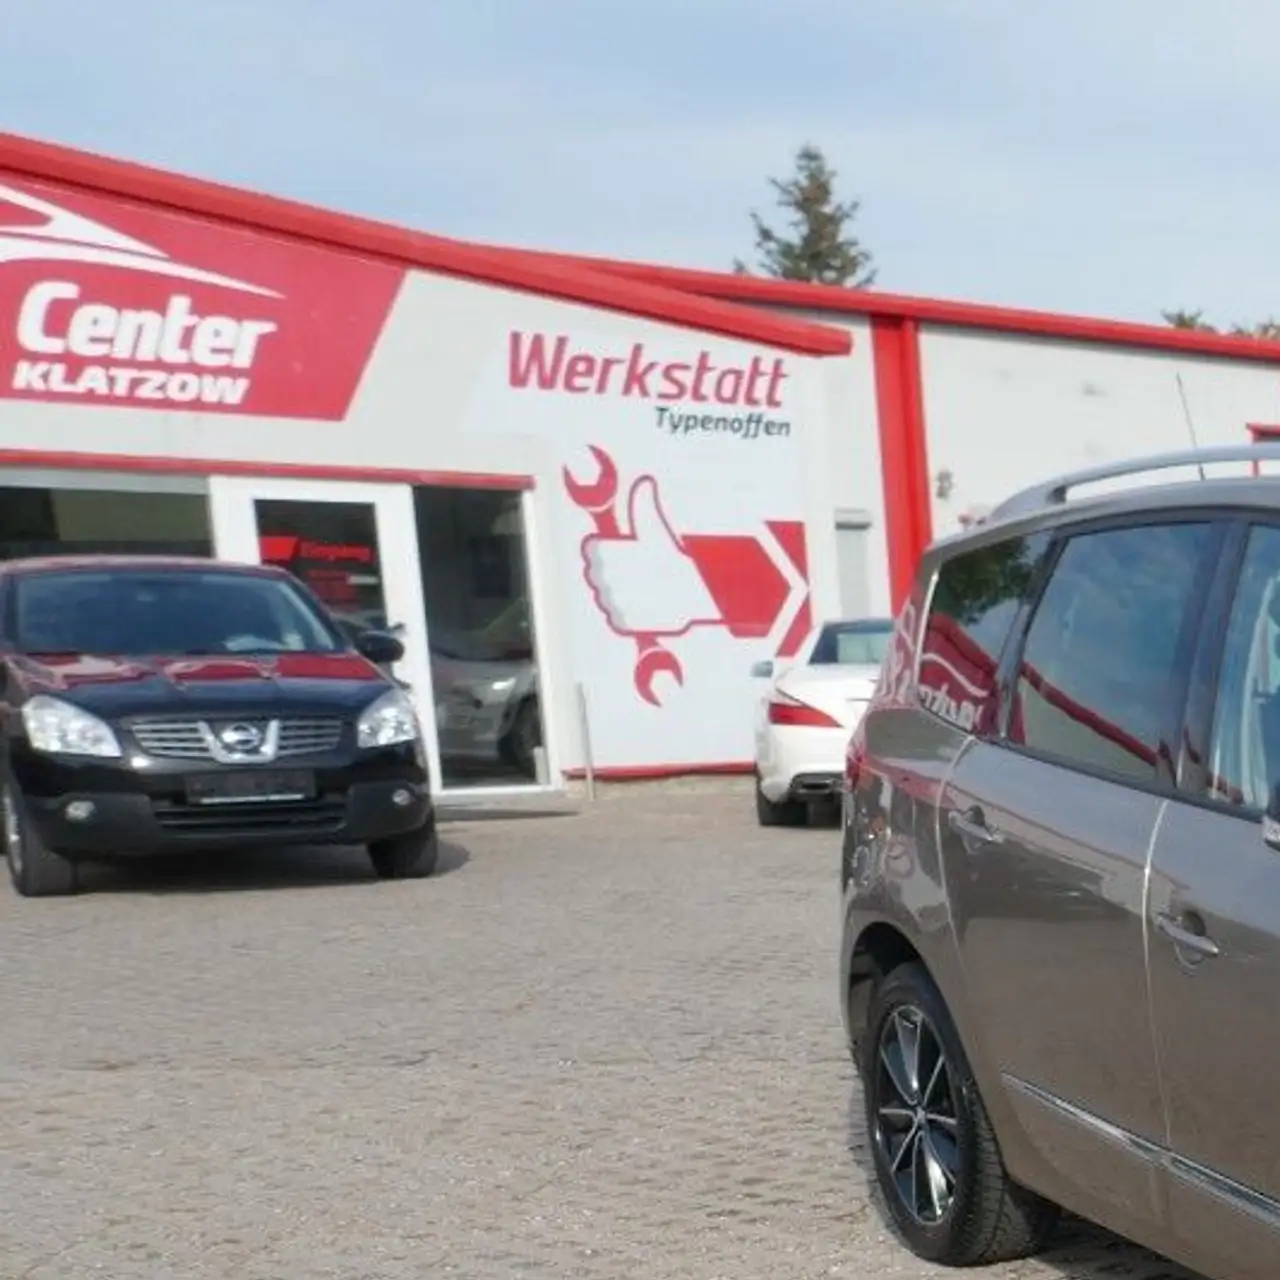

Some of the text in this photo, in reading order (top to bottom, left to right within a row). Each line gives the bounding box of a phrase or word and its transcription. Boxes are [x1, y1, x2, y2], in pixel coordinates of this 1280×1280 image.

[16, 279, 279, 368] Center
[12, 359, 251, 405] KLATZOW
[508, 330, 790, 408] Werkstatt
[655, 406, 791, 438] Typenoffen
